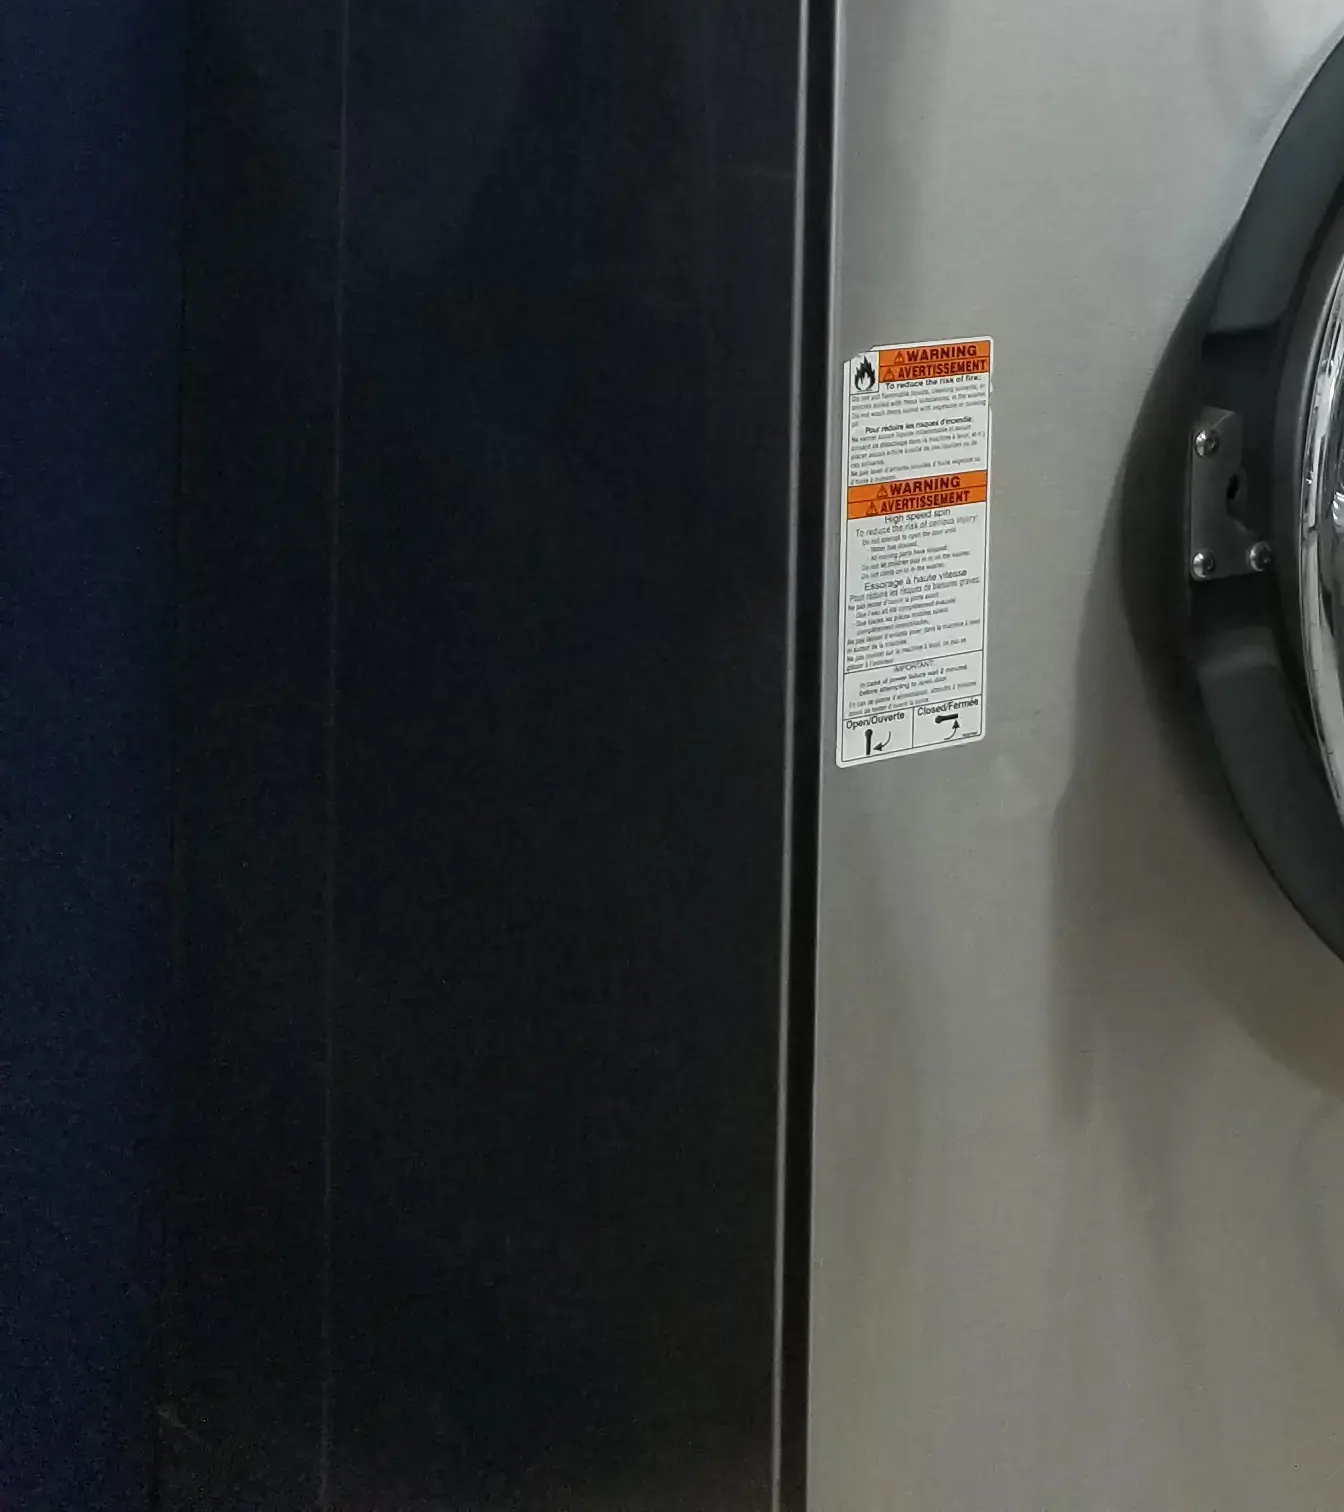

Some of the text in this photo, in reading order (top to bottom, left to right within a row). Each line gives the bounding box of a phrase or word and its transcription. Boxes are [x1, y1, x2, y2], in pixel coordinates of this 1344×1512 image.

[906, 344, 977, 363] WARNING
[897, 358, 987, 380] AVERTISSEMENT
[885, 382, 895, 390] To
[896, 379, 925, 389] reduce
[925, 377, 937, 387] the
[939, 376, 954, 386] risk
[956, 375, 964, 384] of
[889, 475, 961, 496] WARNING
[880, 490, 971, 513] AVERTISSEMENT
[906, 511, 932, 521] speed
[864, 578, 904, 591] Essorage
[913, 572, 937, 584] haute
[938, 568, 968, 580] vitesse
[916, 696, 980, 718] Closed/Fermée
[846, 711, 906, 731] Open/Ouverte
